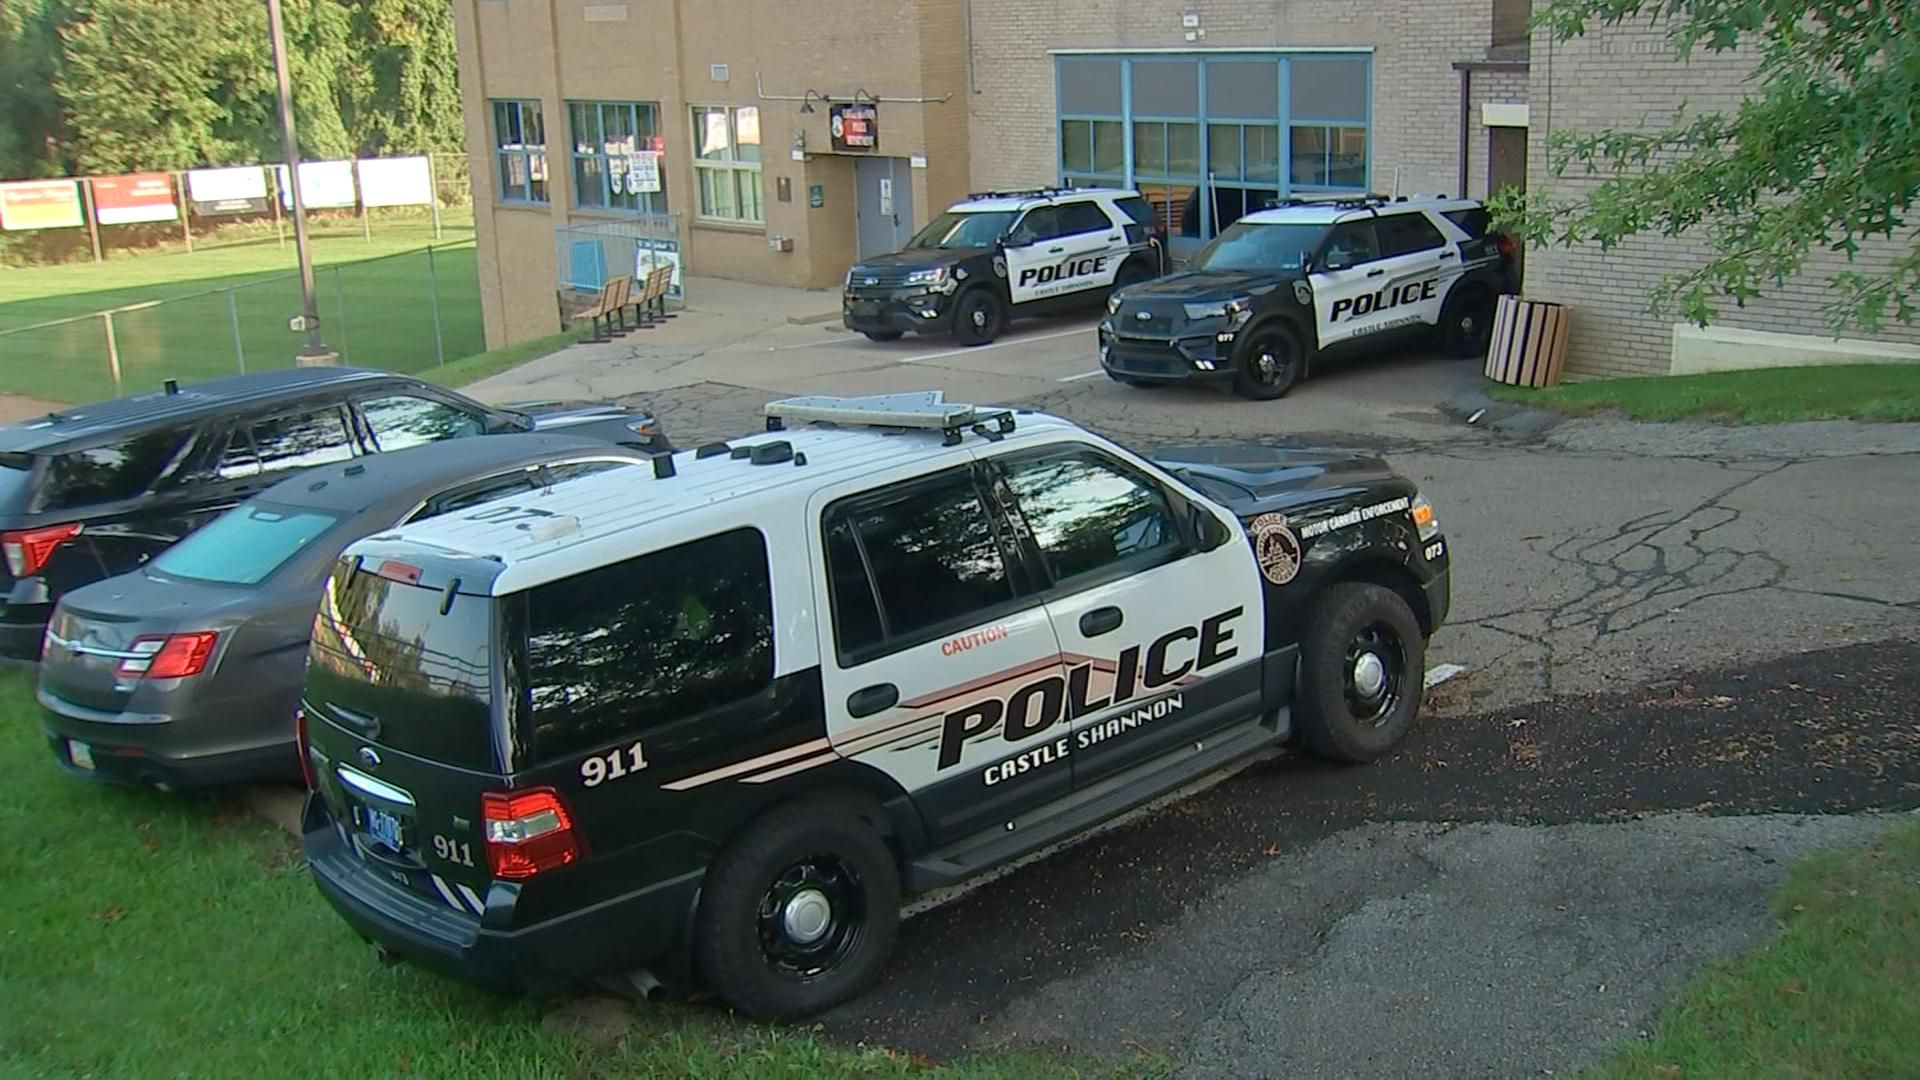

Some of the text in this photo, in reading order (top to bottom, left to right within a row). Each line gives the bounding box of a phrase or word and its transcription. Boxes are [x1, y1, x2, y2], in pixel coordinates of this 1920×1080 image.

[1019, 256, 1108, 288] POLICE
[1329, 278, 1439, 322] POLICE
[1300, 496, 1410, 540] MOTOR CARRIER ENFORCEMENT
[1425, 542, 1443, 561] 073
[941, 624, 1009, 658] CAUTION
[937, 605, 1244, 772] POLICE
[984, 692, 1185, 787] CASTLE SHANNON
[580, 741, 649, 789] 911
[433, 834, 475, 869] 911
